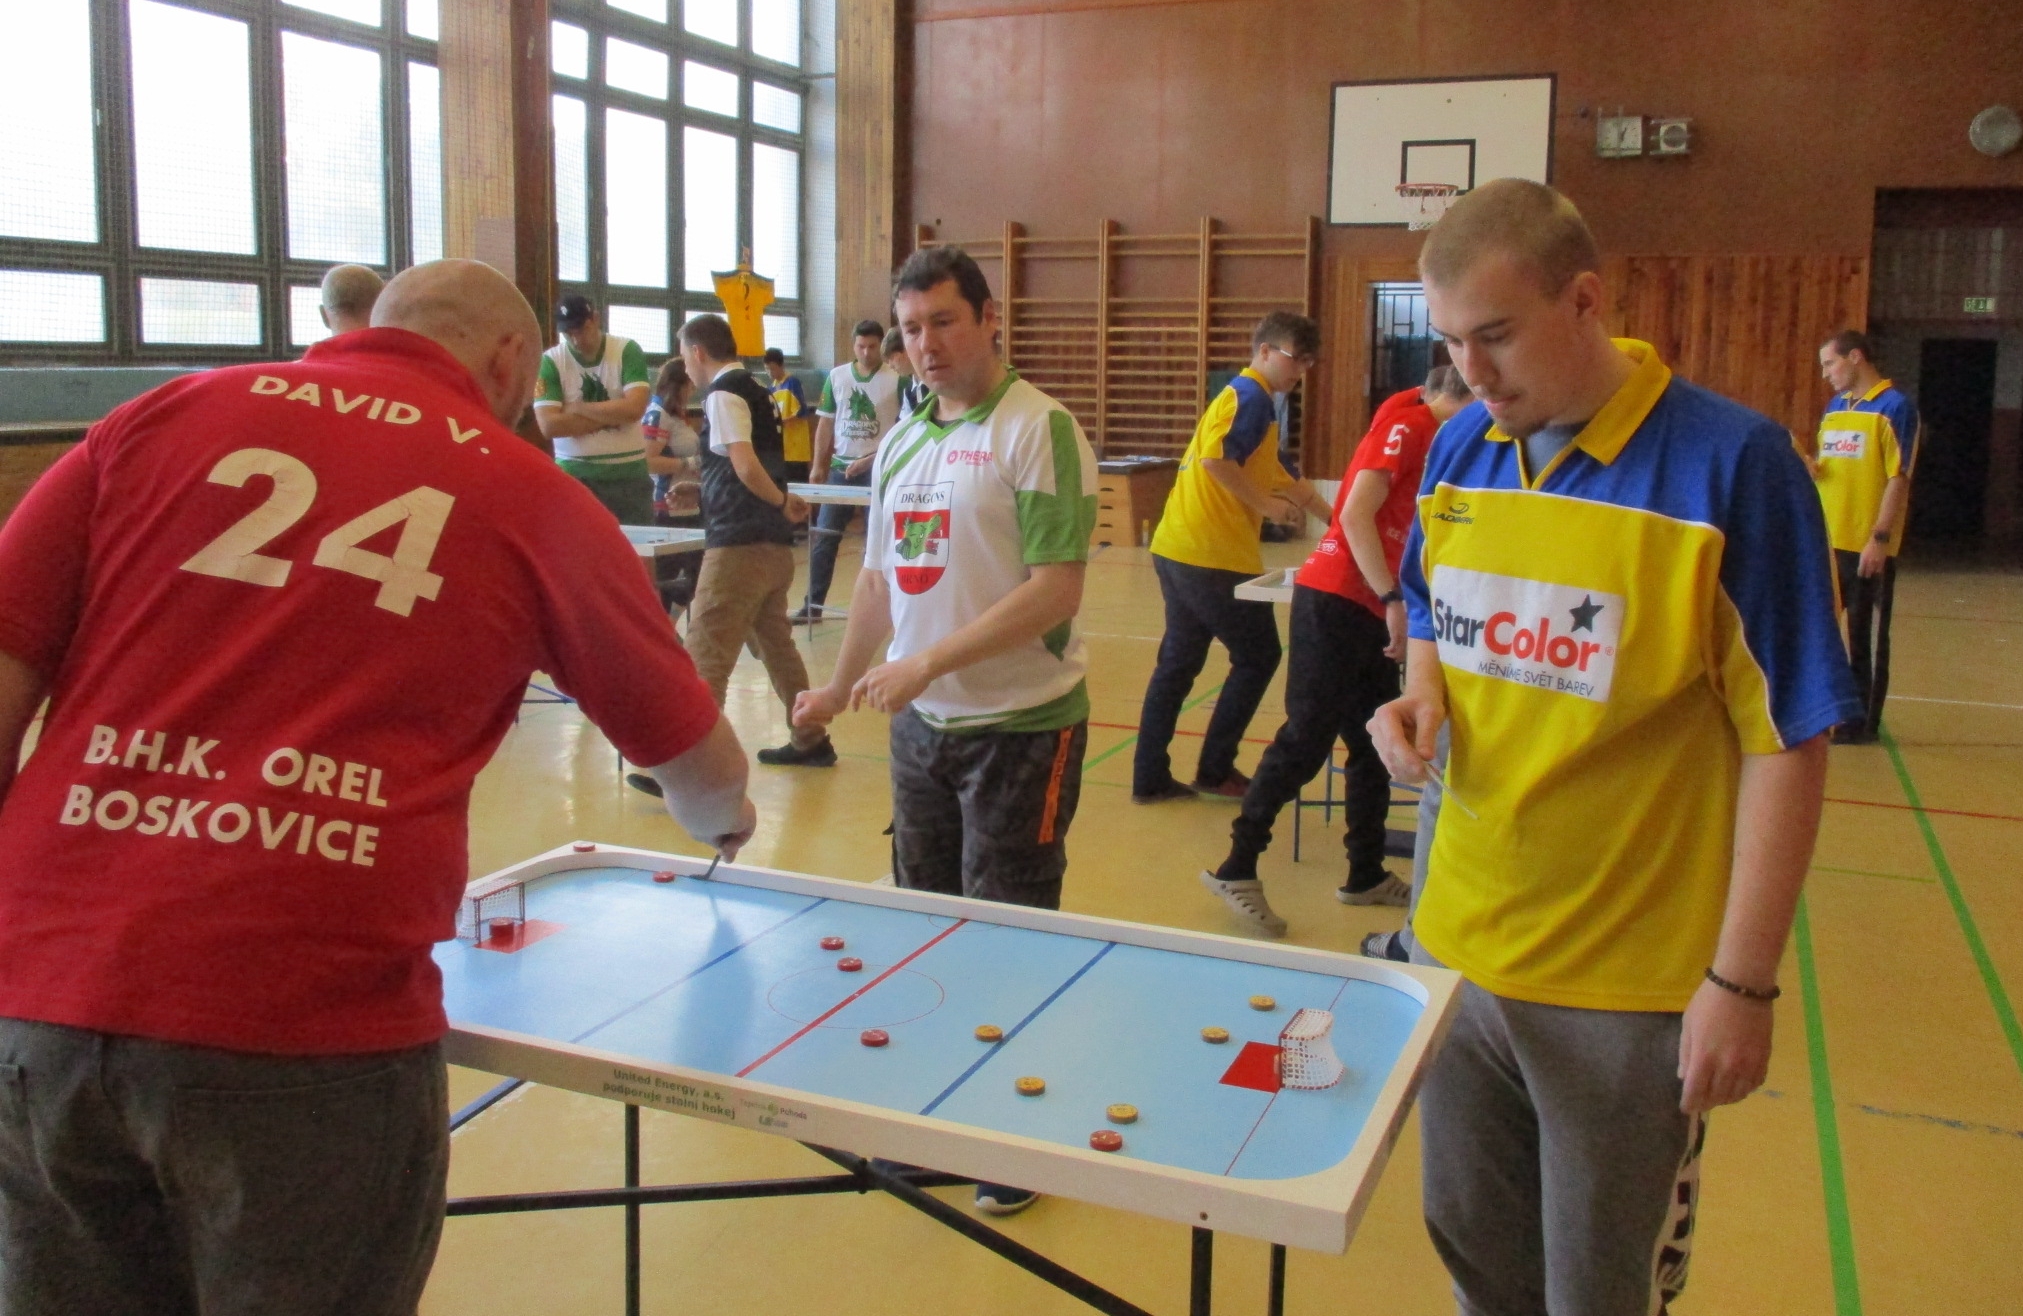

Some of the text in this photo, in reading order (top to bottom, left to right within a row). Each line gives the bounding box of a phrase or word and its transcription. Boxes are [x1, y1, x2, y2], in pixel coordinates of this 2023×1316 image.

[250, 375, 490, 454] DAVID V.
[1384, 423, 1410, 455] 5
[178, 447, 456, 617] 24
[1434, 598, 1600, 672] StarColor
[1524, 670, 1553, 688] SVĚT
[1557, 677, 1595, 698] BAREV
[83, 724, 388, 807] B.H.K. OREL
[59, 784, 380, 867] BOSKOVICE
[602, 1081, 662, 1103] podporuje
[702, 1101, 736, 1120] hokej
[613, 1068, 651, 1085] United
